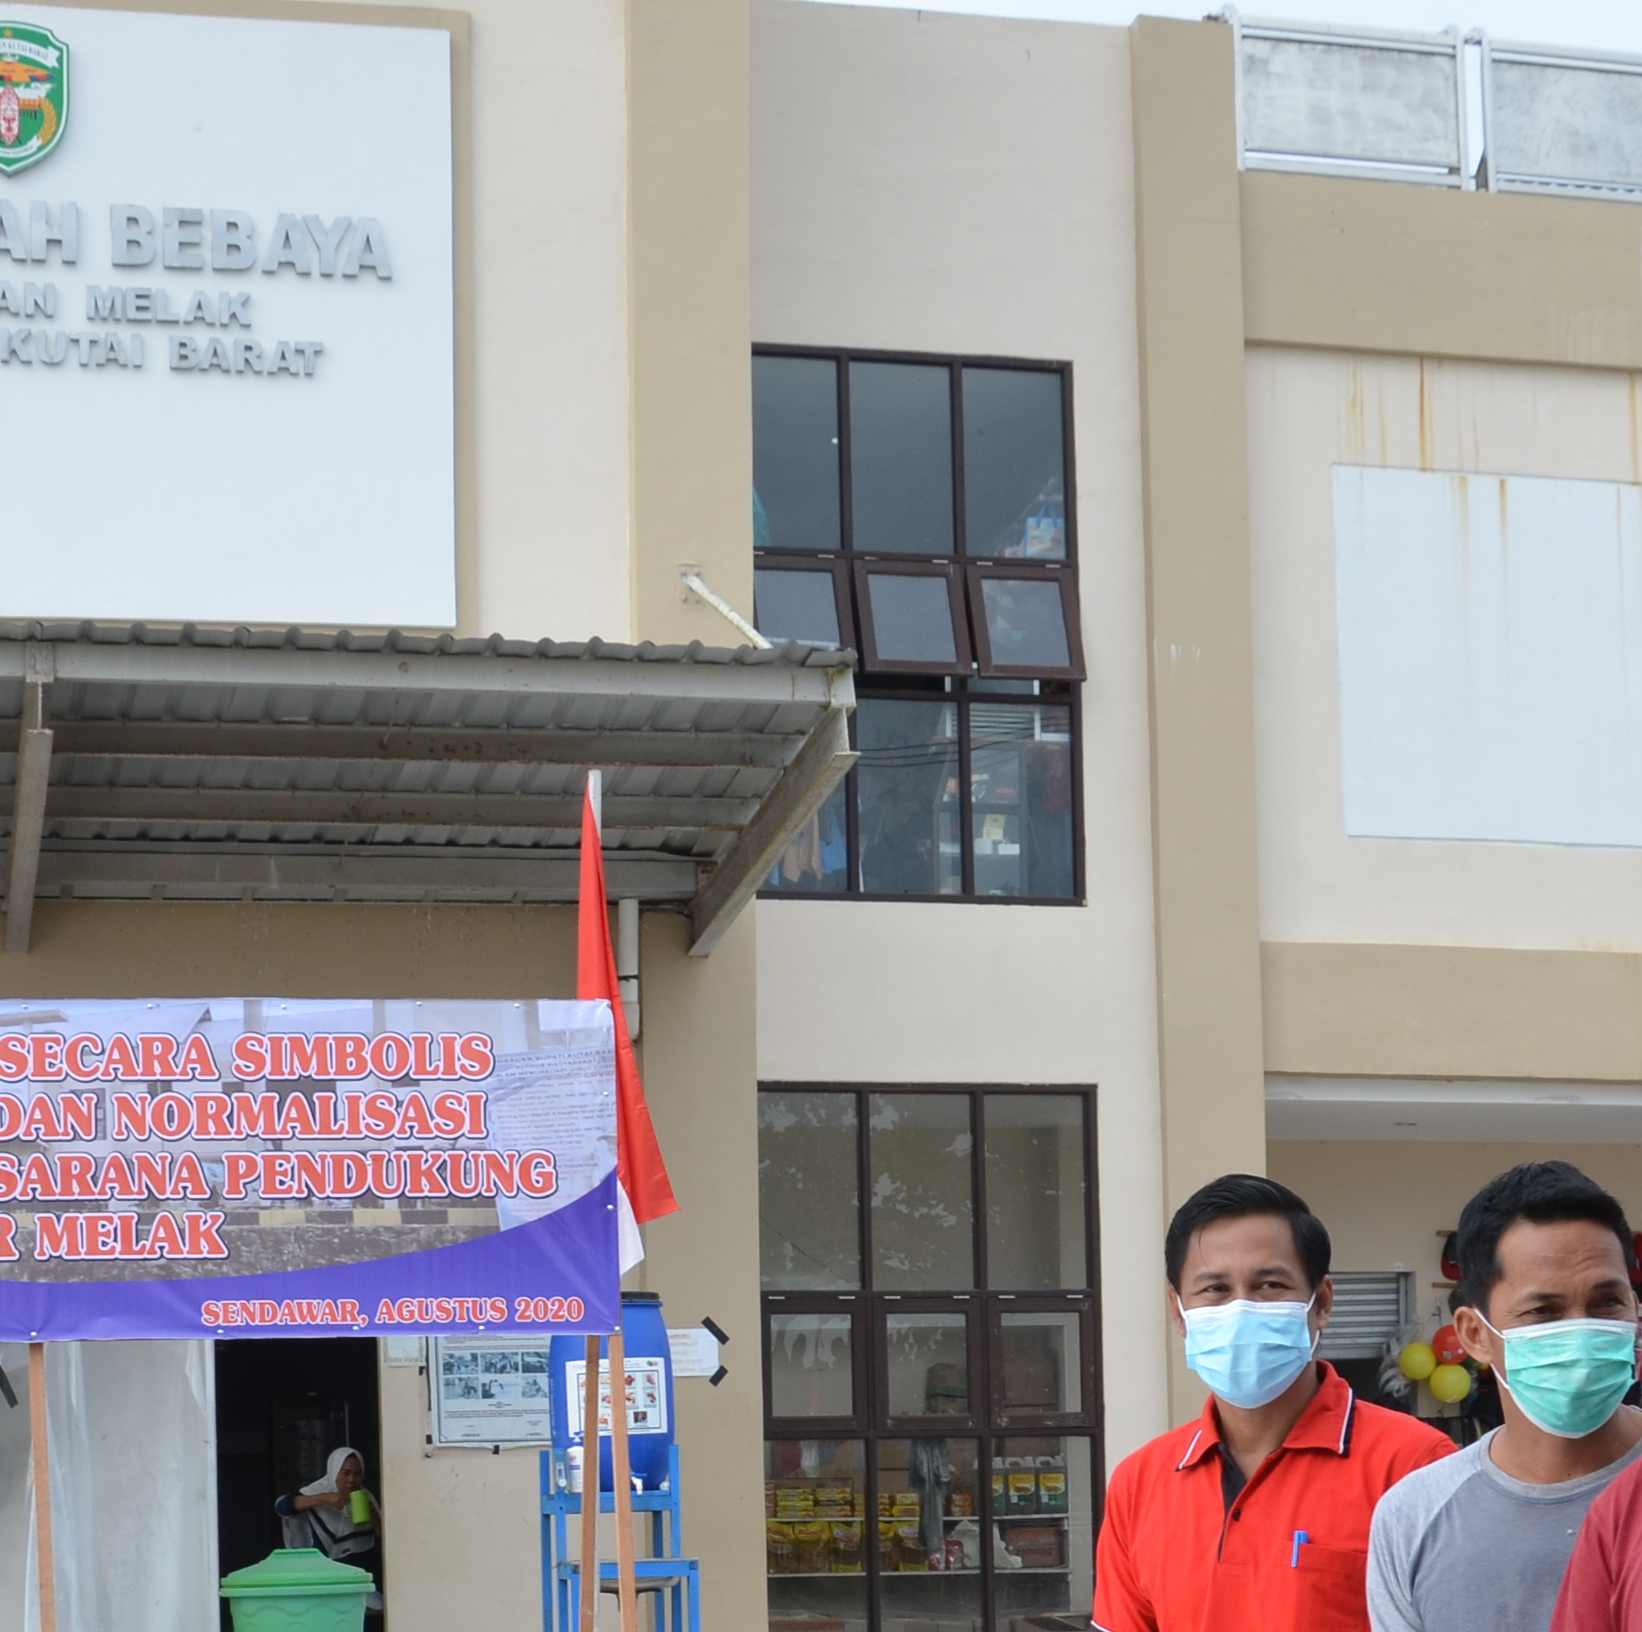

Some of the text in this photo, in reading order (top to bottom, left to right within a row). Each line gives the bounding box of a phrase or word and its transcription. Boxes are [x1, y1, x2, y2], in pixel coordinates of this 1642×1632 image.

[110, 204, 393, 281] BEBAYA
[86, 284, 253, 328] MELAK
[168, 335, 324, 378] BARAT
[232, 1032, 495, 1080] SIMBOLIS
[112, 1091, 487, 1140] NORMALISASI
[223, 1151, 557, 1198] PENDUKUNG
[35, 1211, 229, 1260] MELAK
[202, 1297, 585, 1328] SENDAWAR, AGUSTUS 2020
